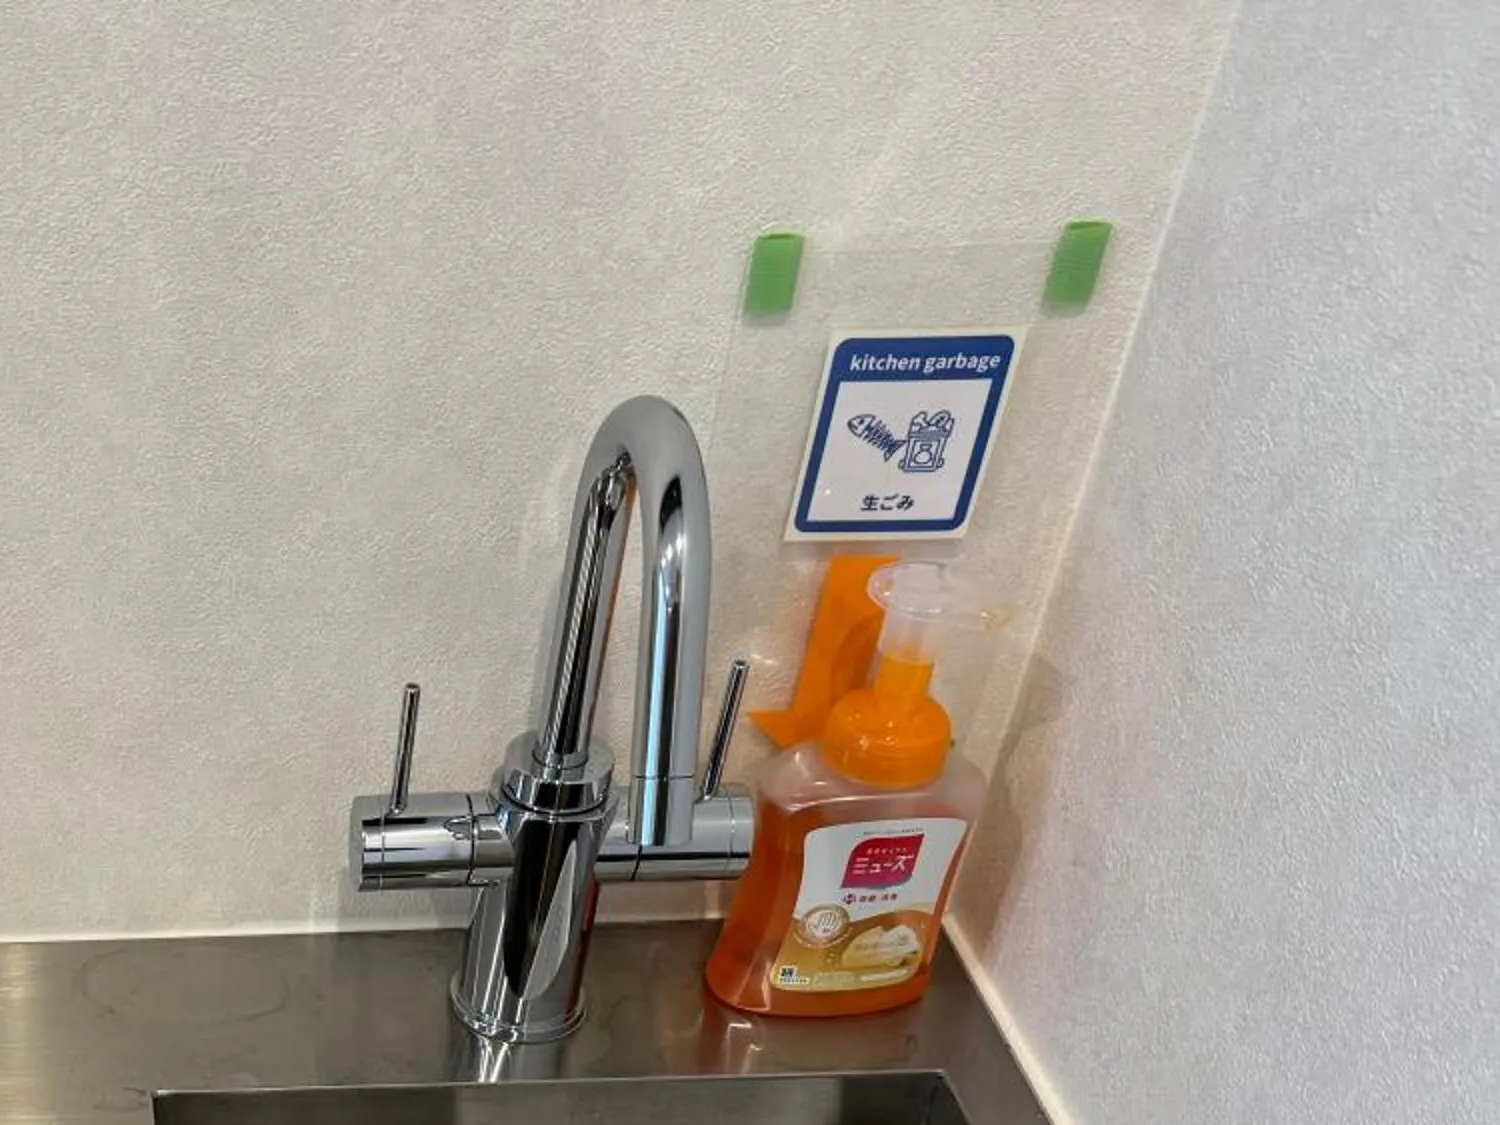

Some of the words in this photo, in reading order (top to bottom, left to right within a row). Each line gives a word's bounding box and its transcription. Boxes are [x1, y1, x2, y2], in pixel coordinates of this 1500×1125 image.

[850, 353, 921, 371] kitchen
[923, 352, 1001, 374] garbage
[860, 494, 915, 511] 生ごみ
[851, 854, 914, 874] ミューズ
